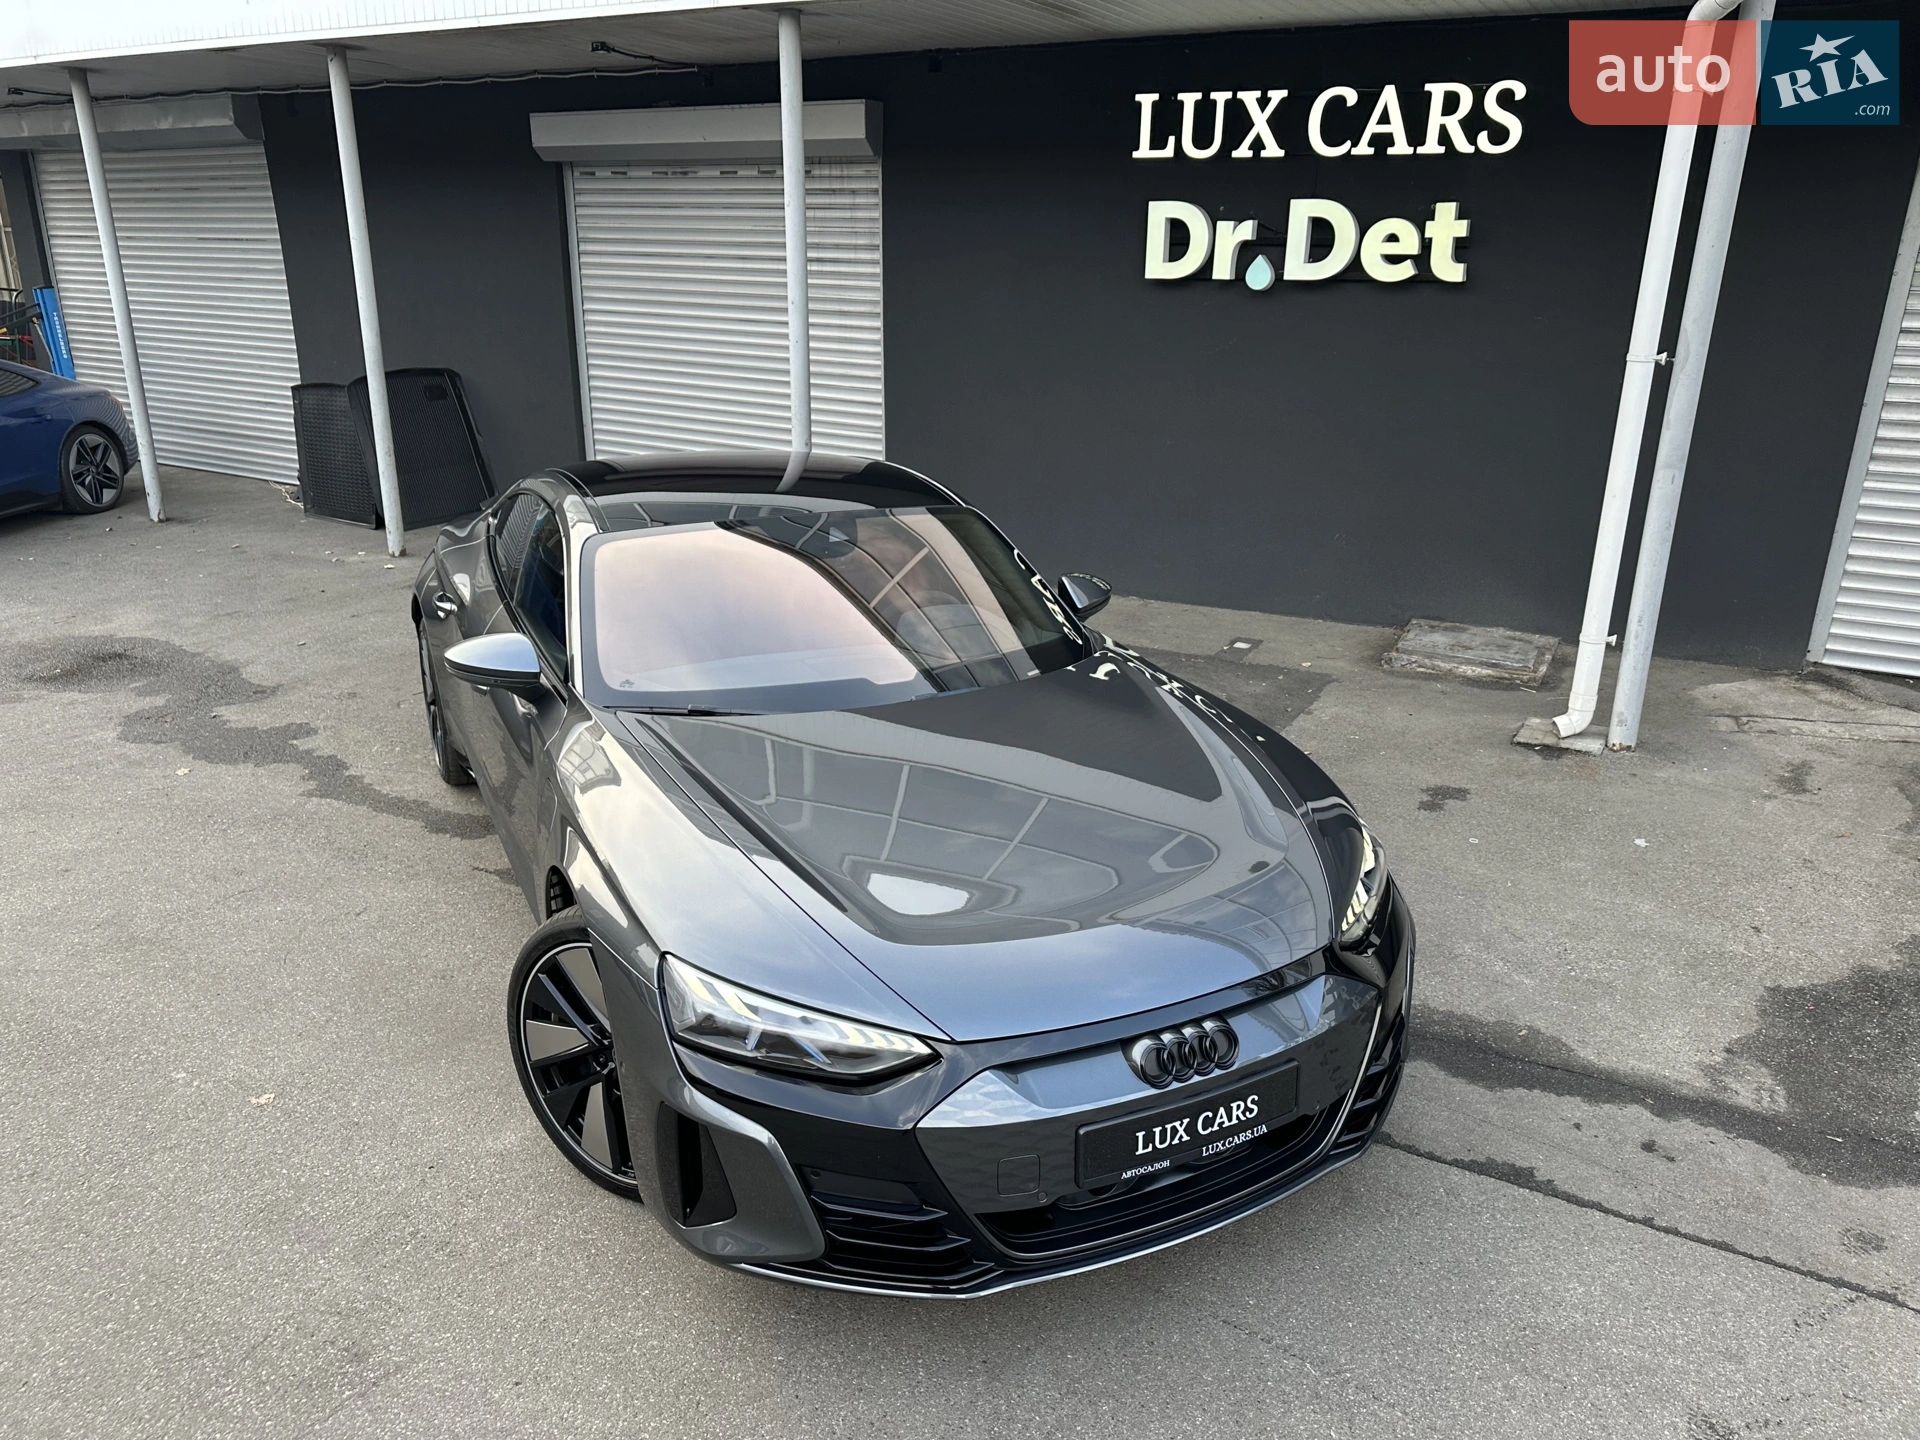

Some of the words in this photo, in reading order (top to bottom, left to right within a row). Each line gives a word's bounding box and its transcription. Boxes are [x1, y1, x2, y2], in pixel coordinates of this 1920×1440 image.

[1132, 88, 1289, 159] LUX
[1307, 79, 1527, 157] CARS
[1135, 1118, 1191, 1155] LUX
[1197, 1095, 1259, 1135] CARS
[1201, 1124, 1268, 1157] LUX.CARS.UA
[1120, 1159, 1170, 1180] АВТОСАЛОН
